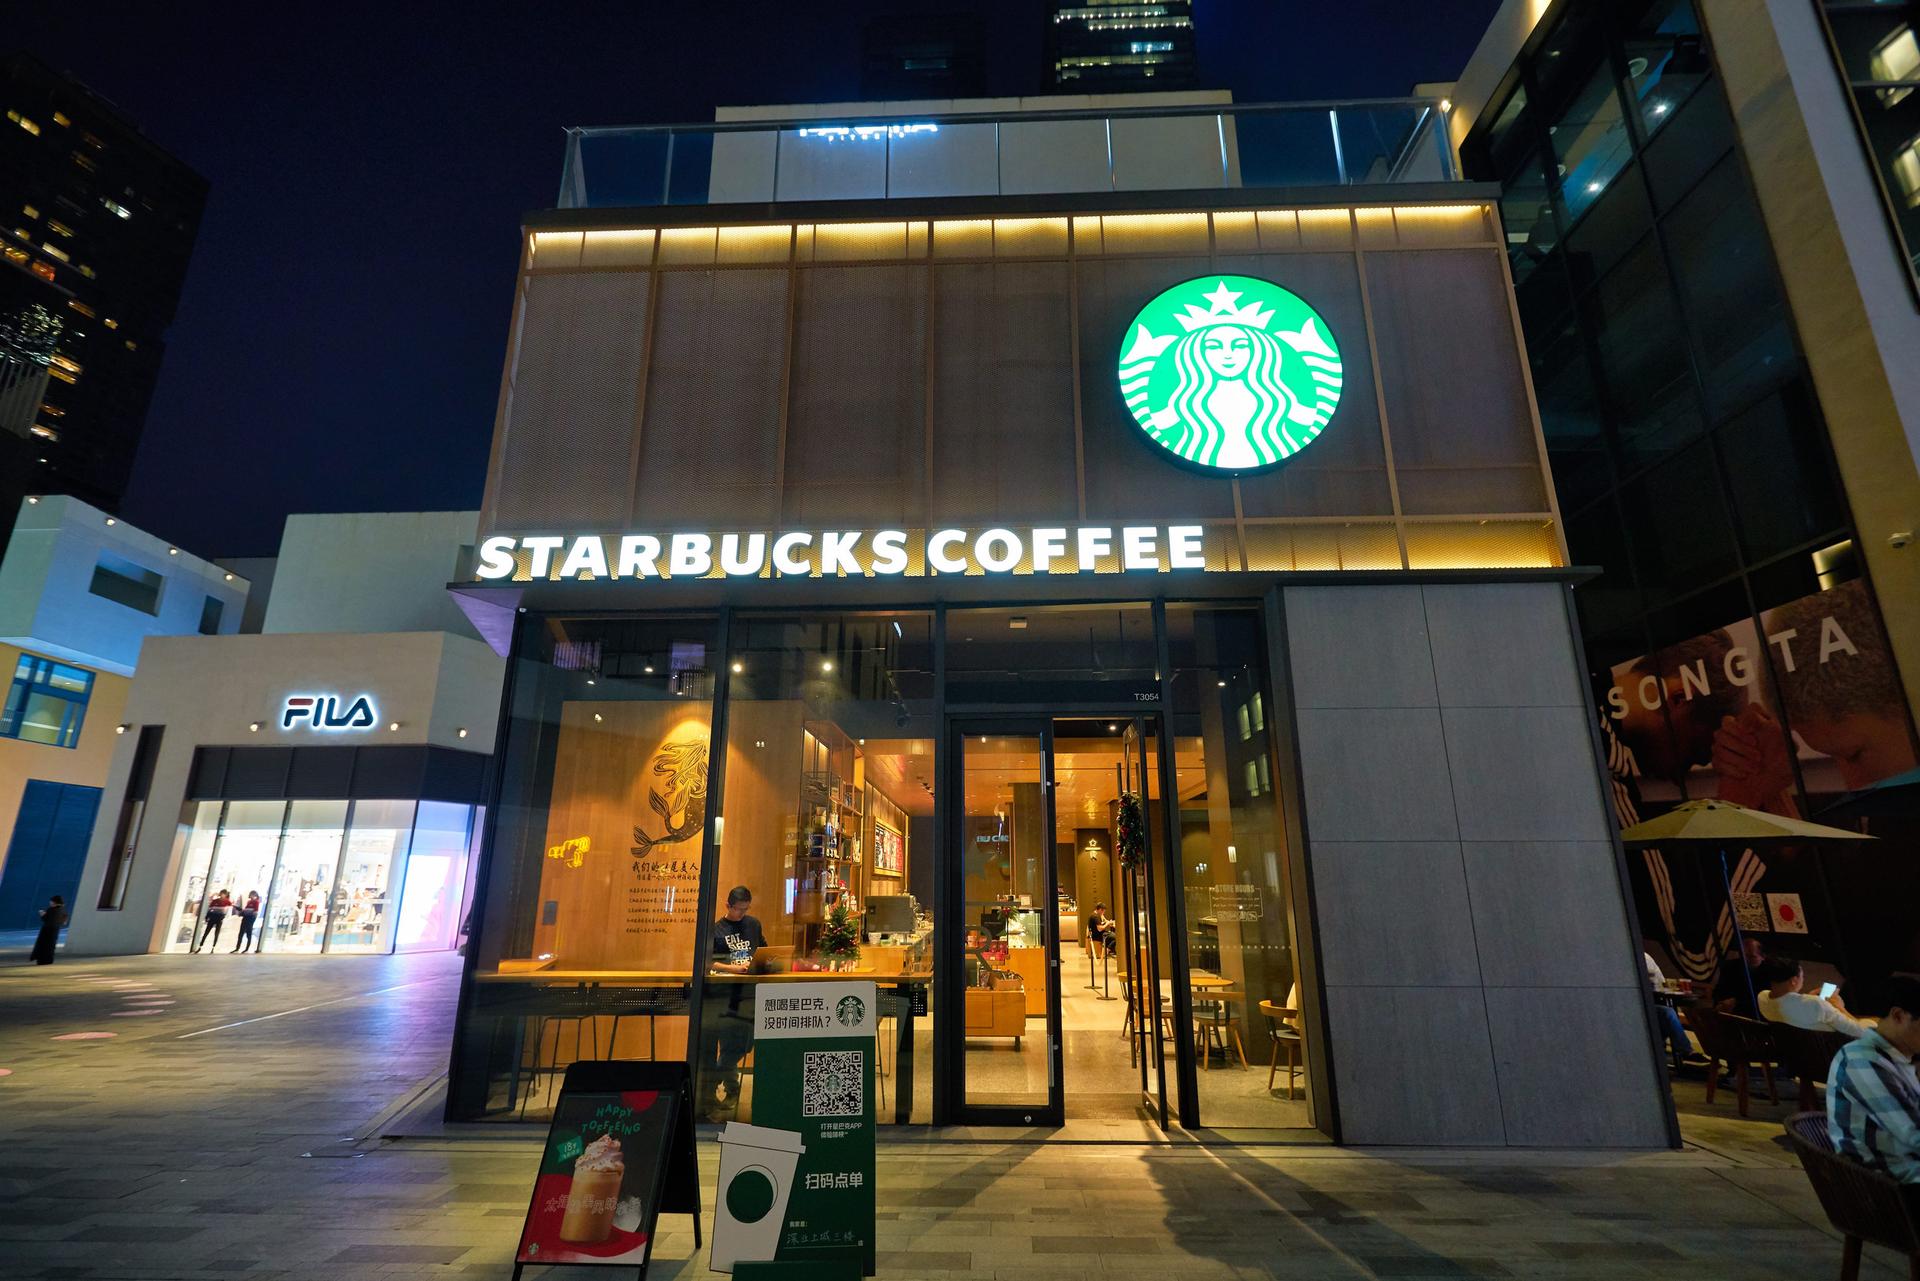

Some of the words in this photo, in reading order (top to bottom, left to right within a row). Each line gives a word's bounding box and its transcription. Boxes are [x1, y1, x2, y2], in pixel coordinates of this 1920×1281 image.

[475, 530, 908, 580] STARBUCKS
[927, 525, 1206, 574] COFFEE
[1606, 615, 1858, 720] SONGTA
[1133, 692, 1159, 701] T3054
[282, 696, 374, 728] FILA
[596, 1103, 633, 1119] HAPPY
[581, 1120, 641, 1136] TOFFEEING
[805, 1172, 864, 1190] 扫码点单
